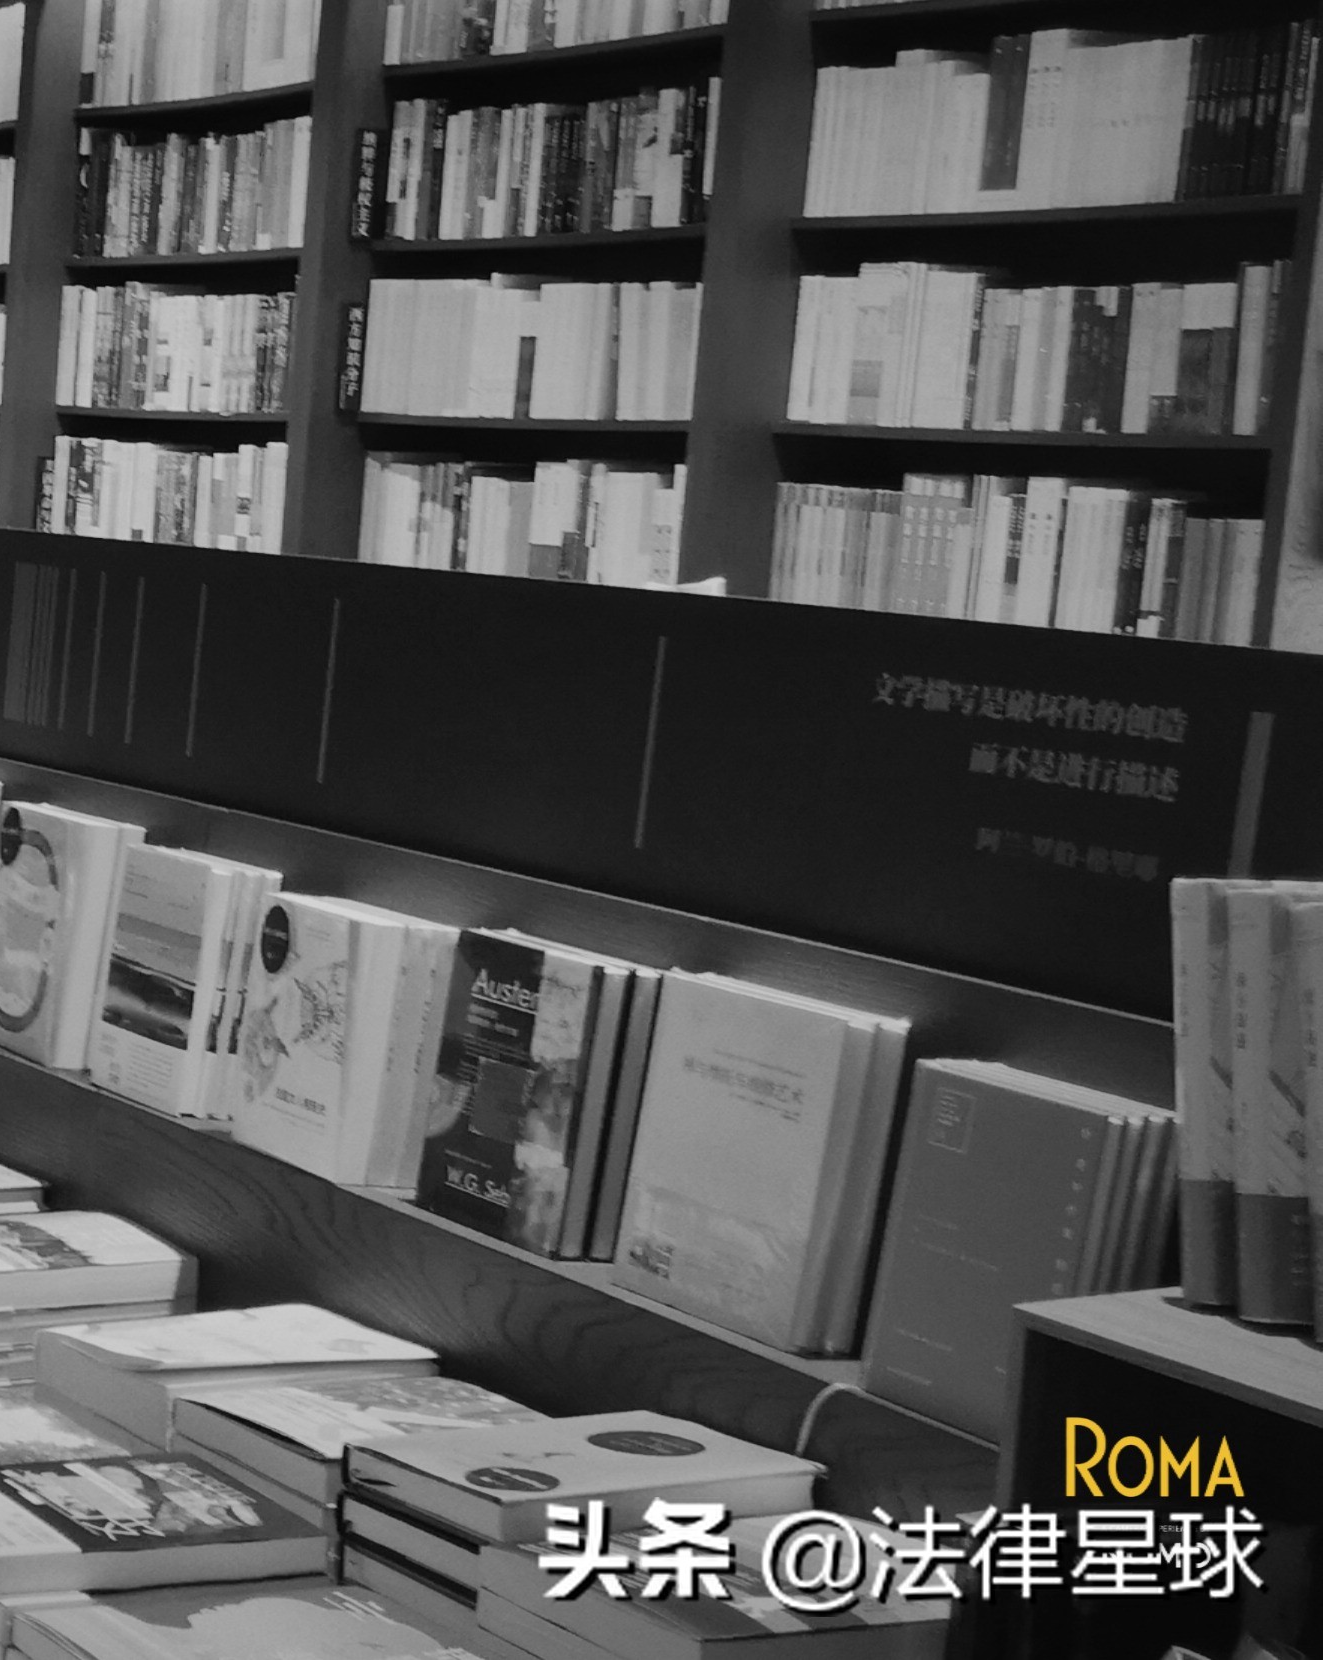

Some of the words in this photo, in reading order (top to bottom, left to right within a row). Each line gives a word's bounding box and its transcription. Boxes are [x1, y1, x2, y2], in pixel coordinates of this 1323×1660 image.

[871, 671, 1189, 743] 文学描写是破坏性的创造
[967, 742, 1181, 803] 而不是进行描述
